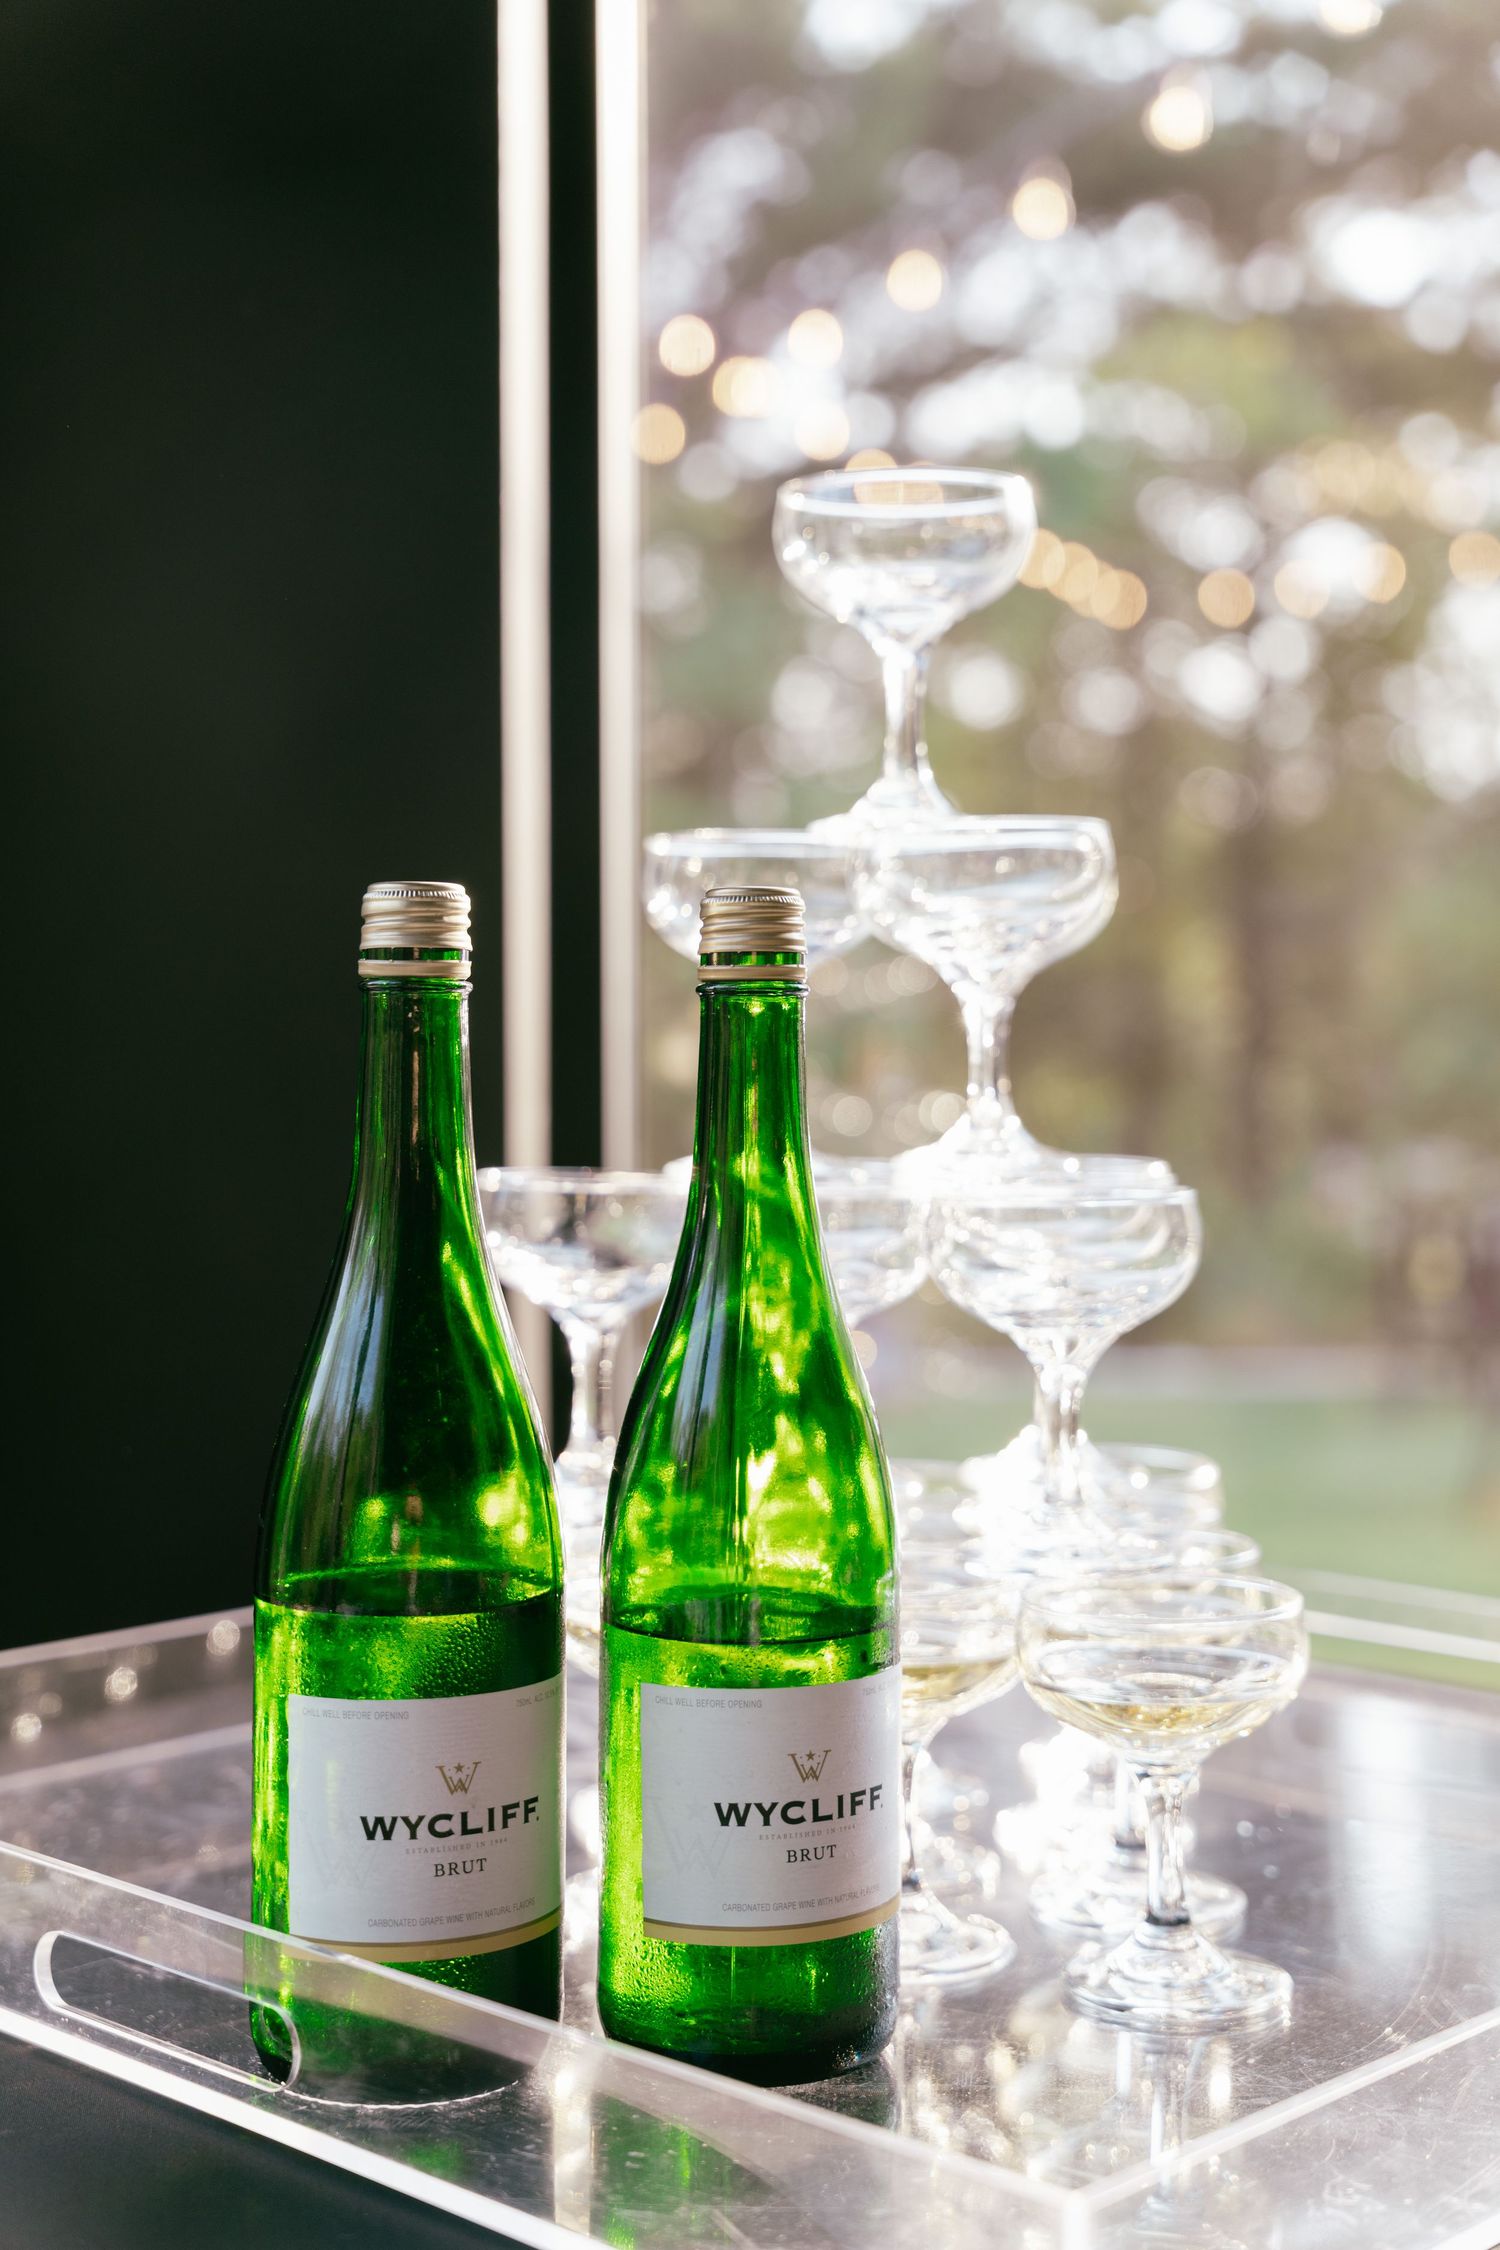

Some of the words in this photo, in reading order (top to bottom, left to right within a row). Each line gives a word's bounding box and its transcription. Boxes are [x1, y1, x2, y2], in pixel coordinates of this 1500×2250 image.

[655, 1695, 674, 1706] CHILL
[675, 1696, 694, 1707] WELL
[696, 1698, 726, 1708] BEFORE
[727, 1699, 762, 1709] OPENING
[342, 1710, 371, 1720] BEFORE
[374, 1710, 409, 1720] OPENING
[759, 1829, 823, 1841] ESTABLISHED
[826, 1827, 836, 1835] IN
[405, 1843, 472, 1855] ESTABLISHED
[786, 1844, 837, 1863] BRUT
[434, 1857, 487, 1878] BRUT
[721, 1902, 771, 1912] CARBONATED
[772, 1900, 797, 1911] GRAPE
[798, 1898, 816, 1909] WINE
[817, 1896, 833, 1907] WITH
[834, 1890, 859, 1904] NATURAL
[367, 1918, 417, 1928] CARBONATED
[419, 1916, 444, 1927] GRAPE
[446, 1913, 464, 1924] WINE
[465, 1910, 483, 1921] WITH
[484, 1905, 511, 1918] NATURAL
